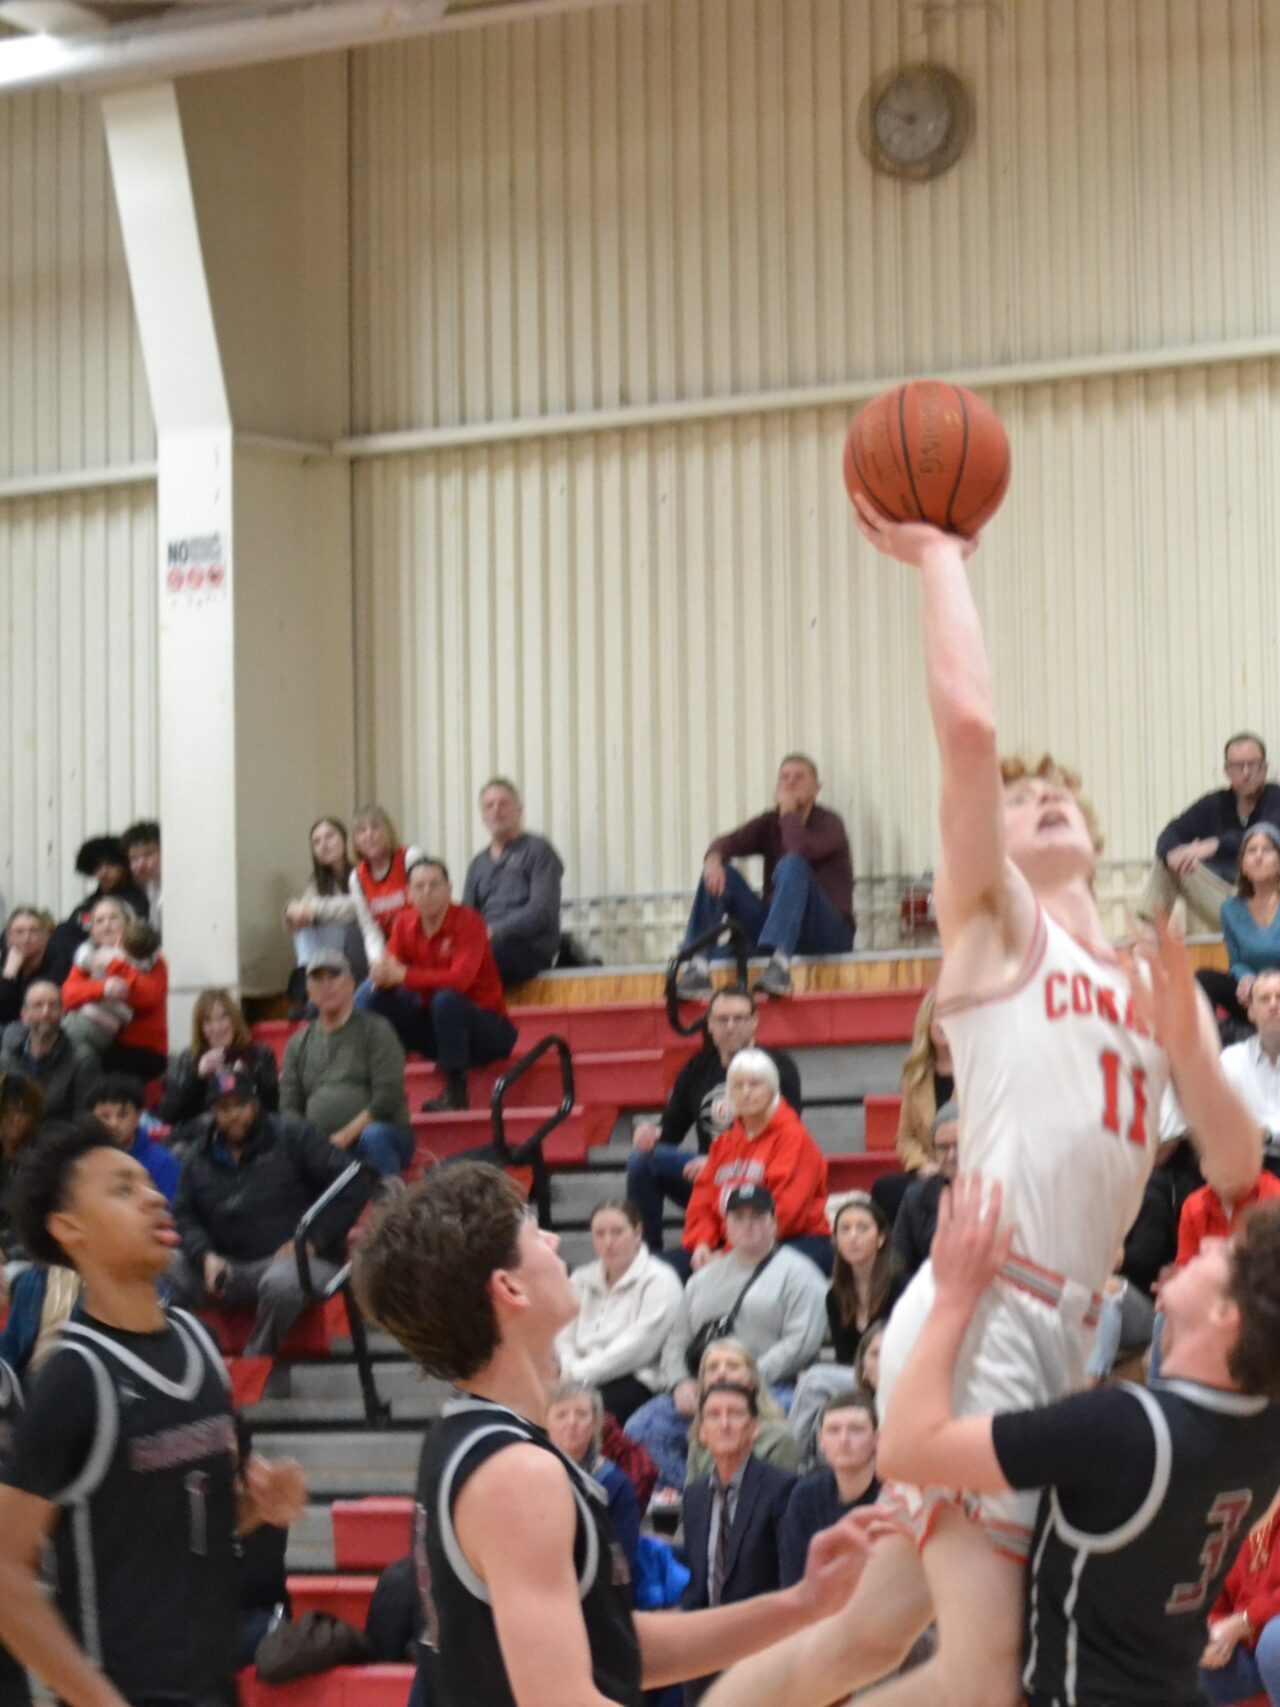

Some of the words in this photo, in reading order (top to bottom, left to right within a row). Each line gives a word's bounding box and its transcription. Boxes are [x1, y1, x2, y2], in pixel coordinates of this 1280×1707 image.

[167, 539, 189, 565] NO
[1100, 1049, 1148, 1148] 11
[1165, 1488, 1253, 1615] 3
